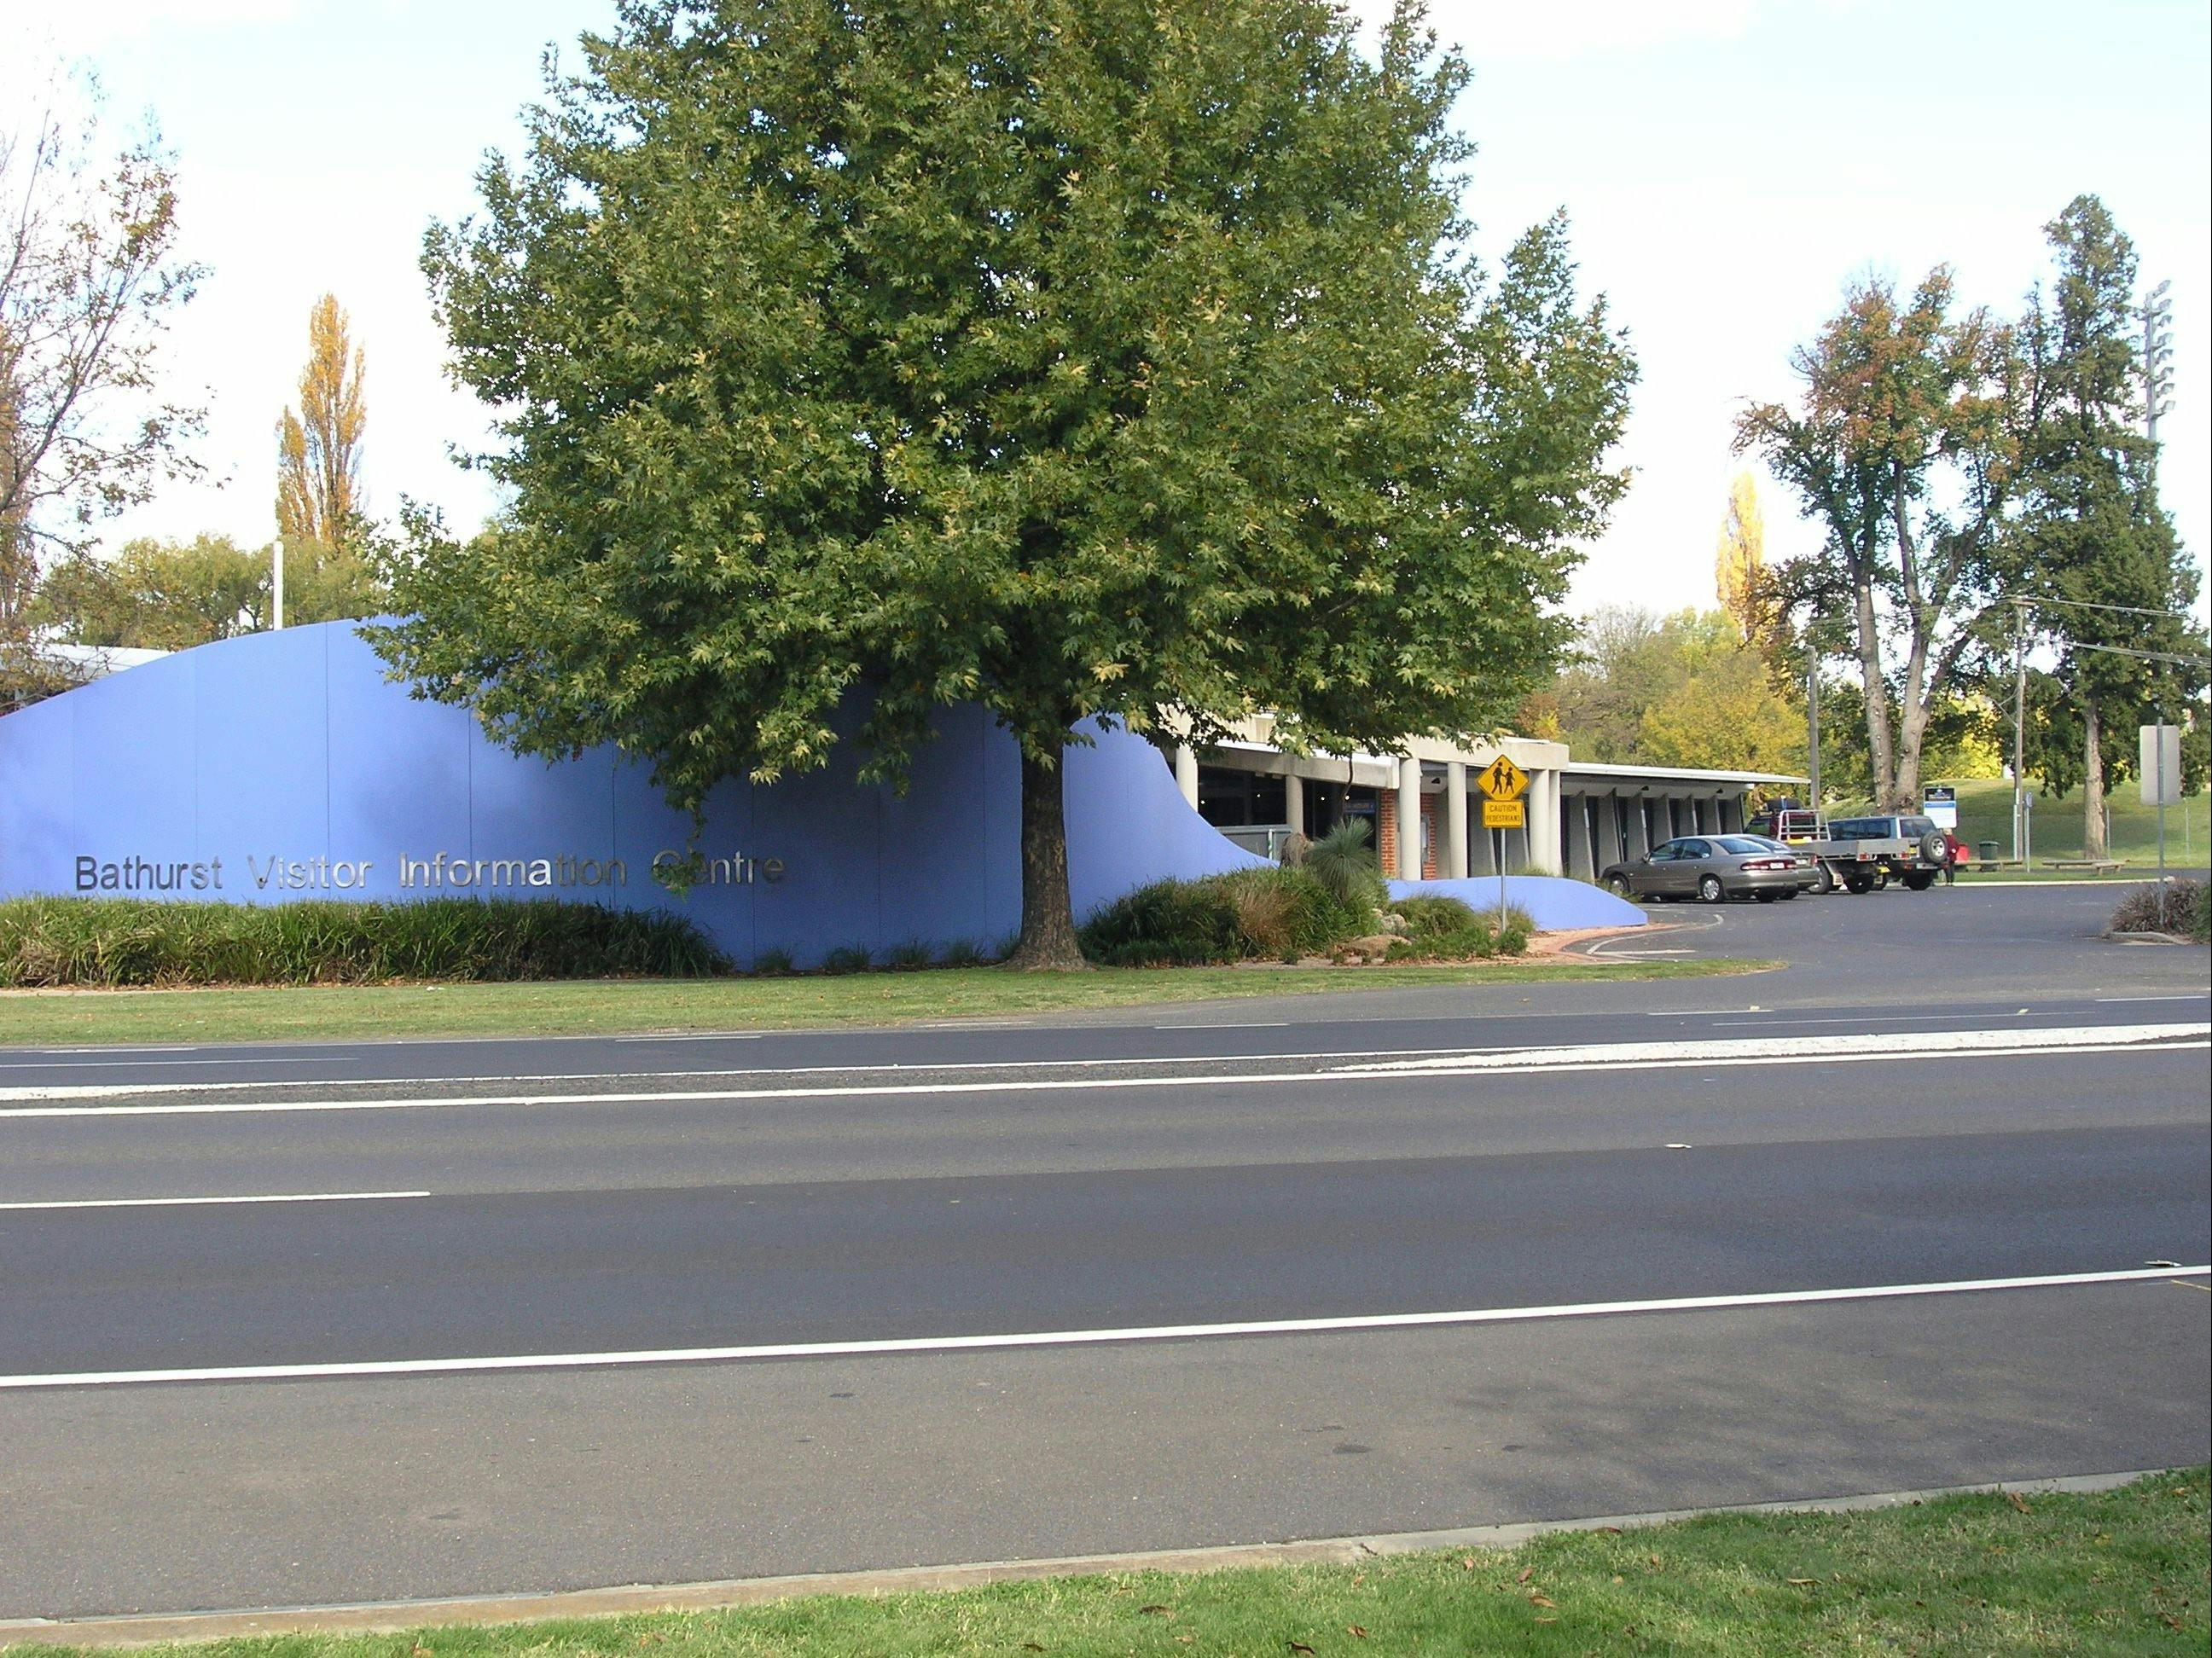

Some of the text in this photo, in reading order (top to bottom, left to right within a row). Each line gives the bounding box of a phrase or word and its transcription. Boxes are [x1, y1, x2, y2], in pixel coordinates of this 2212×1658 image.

[1489, 804, 1517, 813] CAUTION
[76, 855, 223, 890] Bathurst
[247, 854, 373, 889] Visitor
[399, 850, 627, 887] Information
